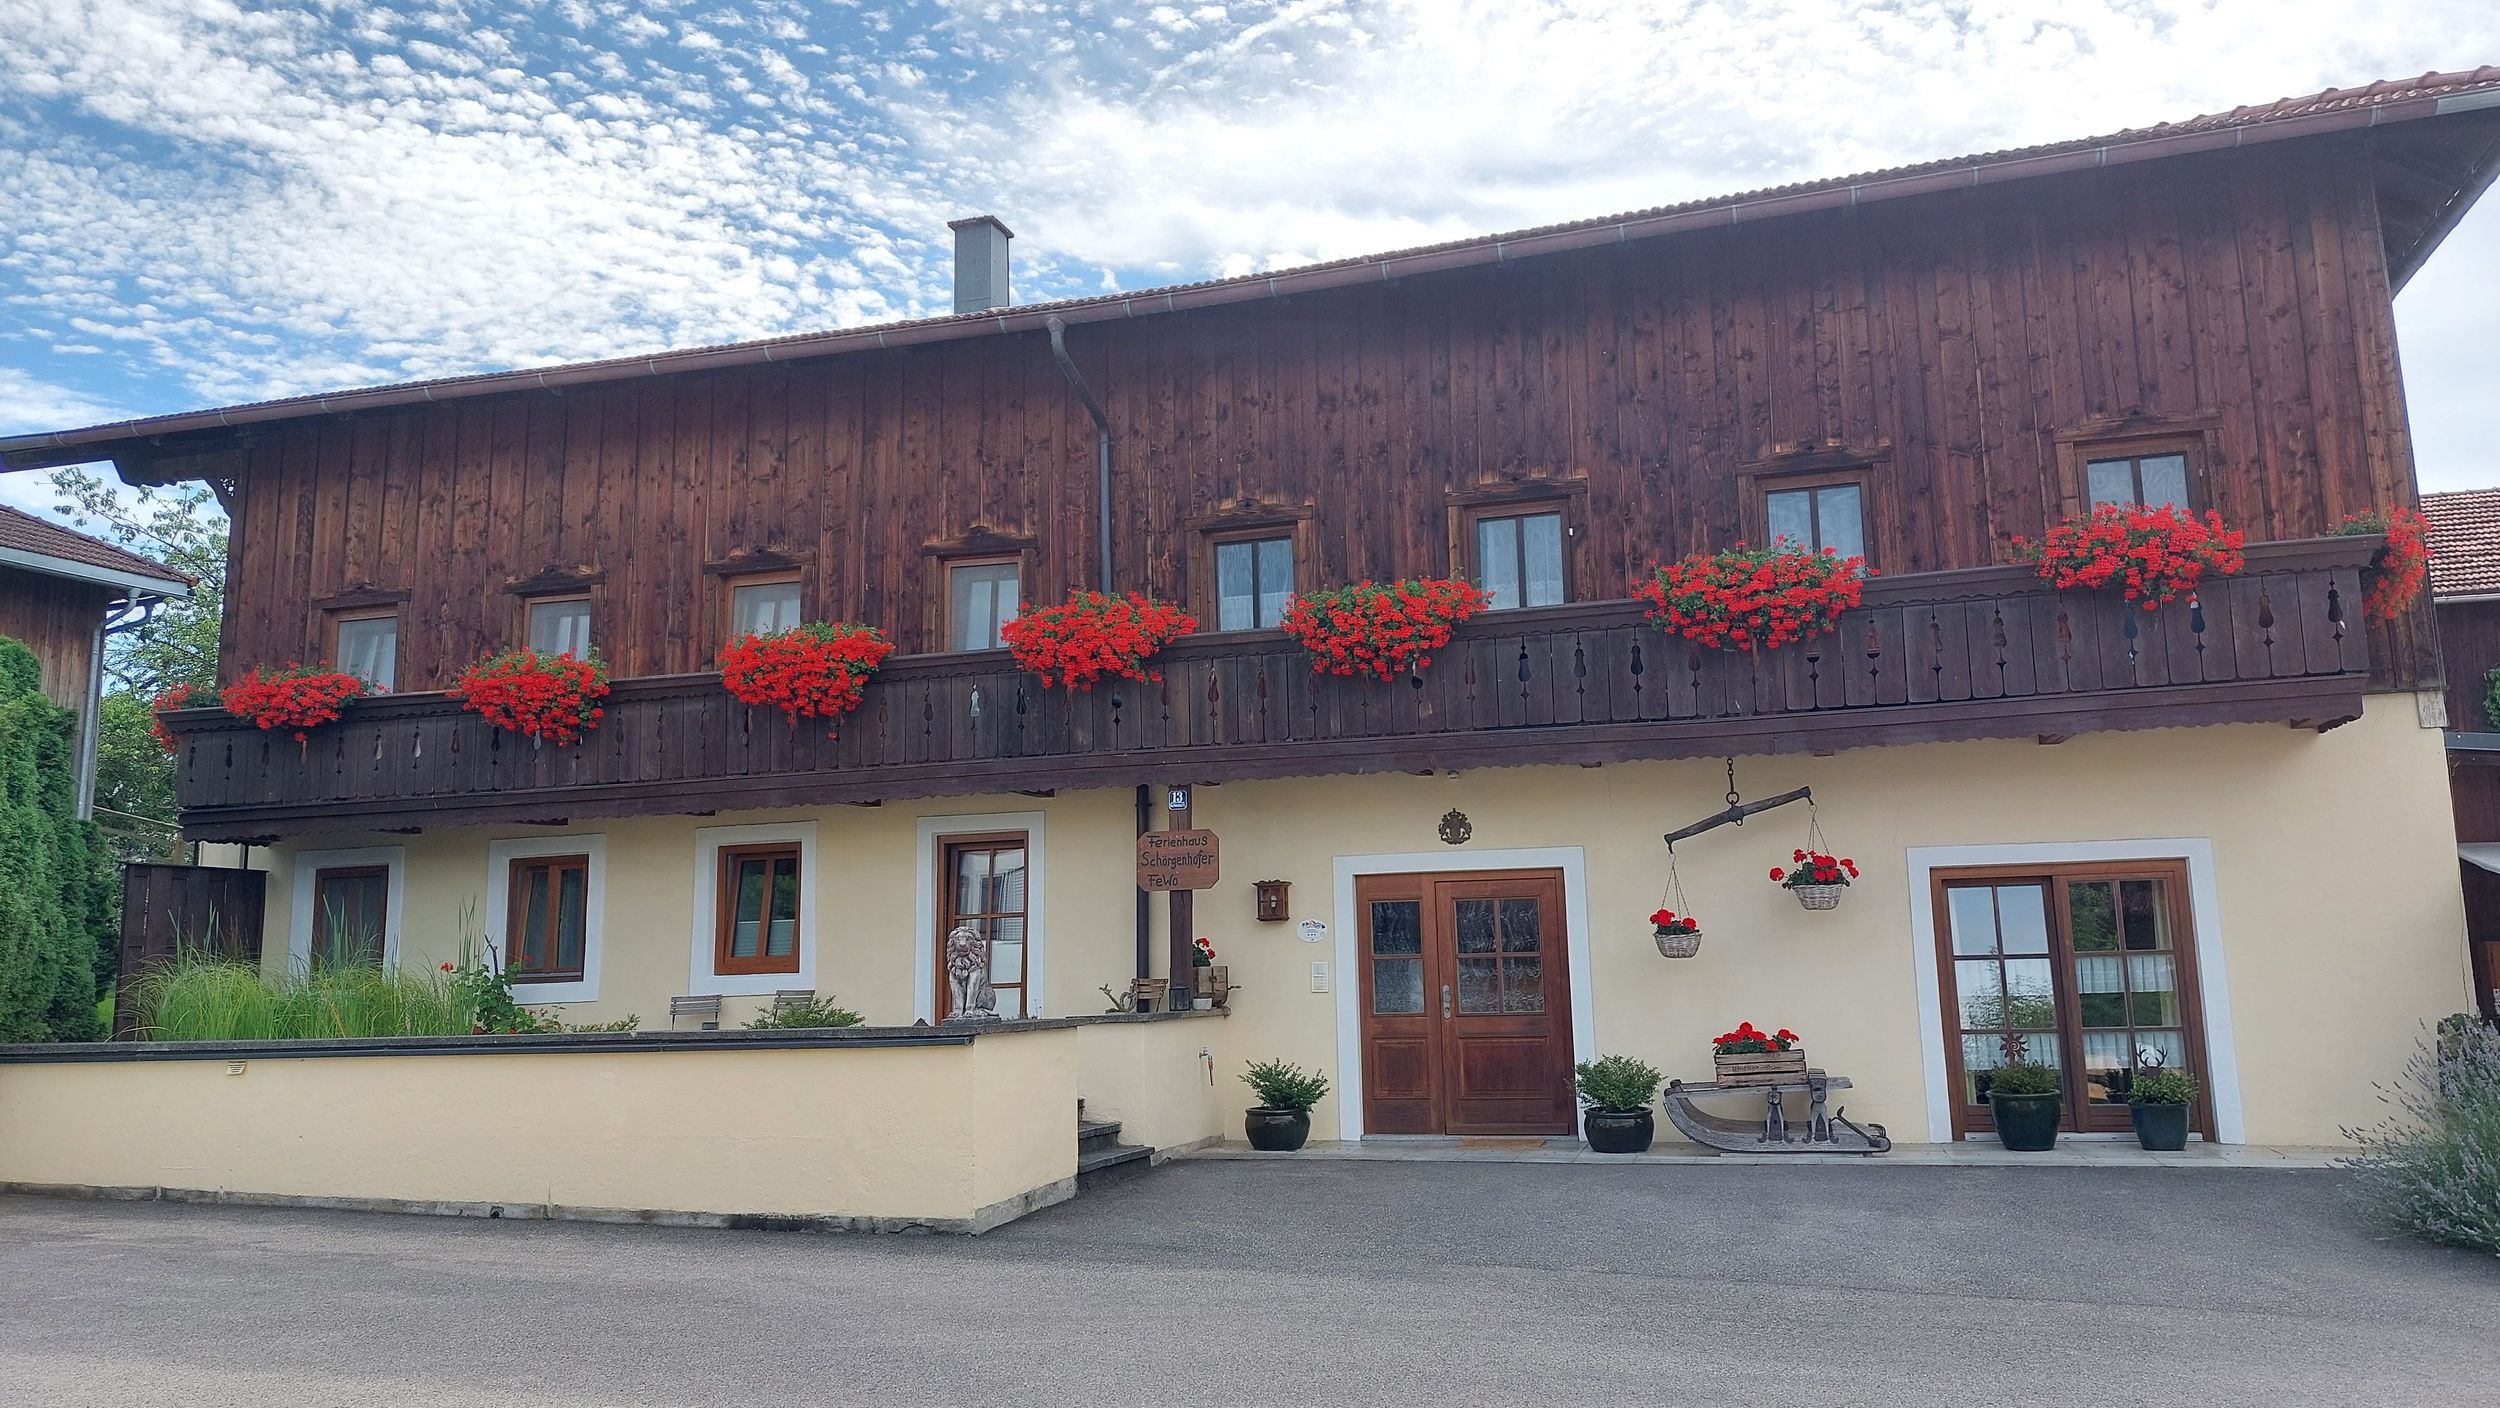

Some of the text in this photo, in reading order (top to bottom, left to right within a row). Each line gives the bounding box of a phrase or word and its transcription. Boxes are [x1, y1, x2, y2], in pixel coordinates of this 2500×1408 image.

[1171, 791, 1183, 803] 13
[1146, 835, 1208, 848] Ferienhaus
[1140, 850, 1215, 869] Schörgenhofer
[1146, 874, 1179, 887] FeWo
